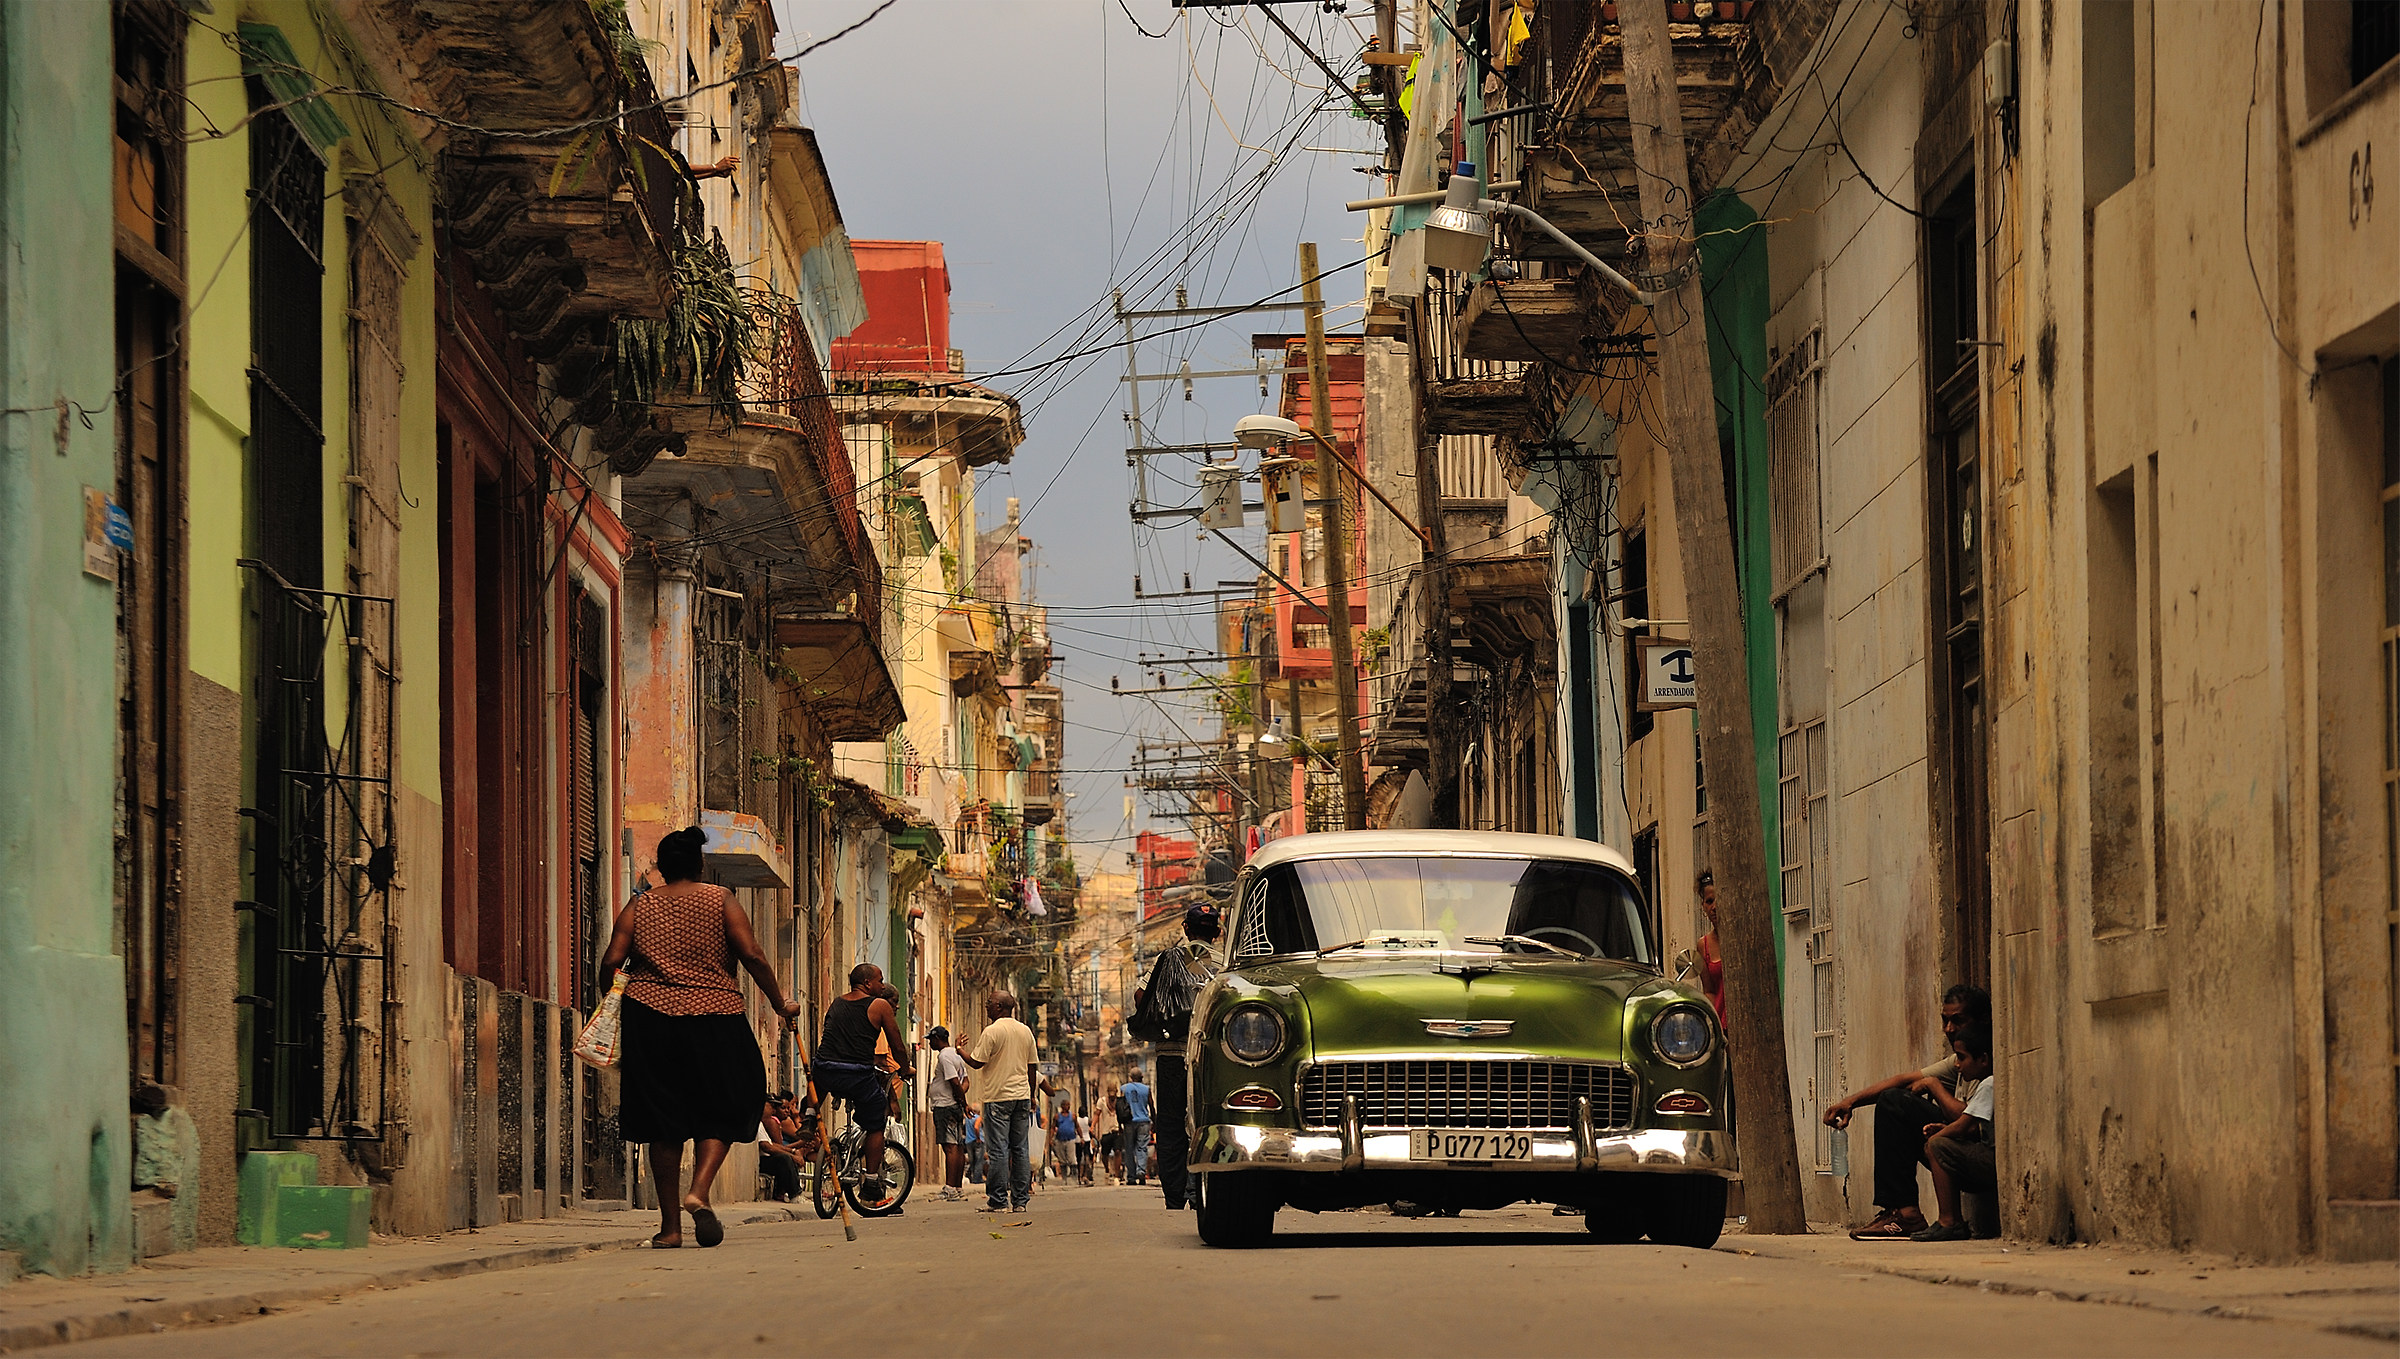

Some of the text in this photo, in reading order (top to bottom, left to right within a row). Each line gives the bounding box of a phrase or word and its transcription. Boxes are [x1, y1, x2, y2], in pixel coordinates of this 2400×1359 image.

[1653, 687, 1695, 697] ARRENDADOR
[1427, 1134, 1530, 1159] P 077 129
